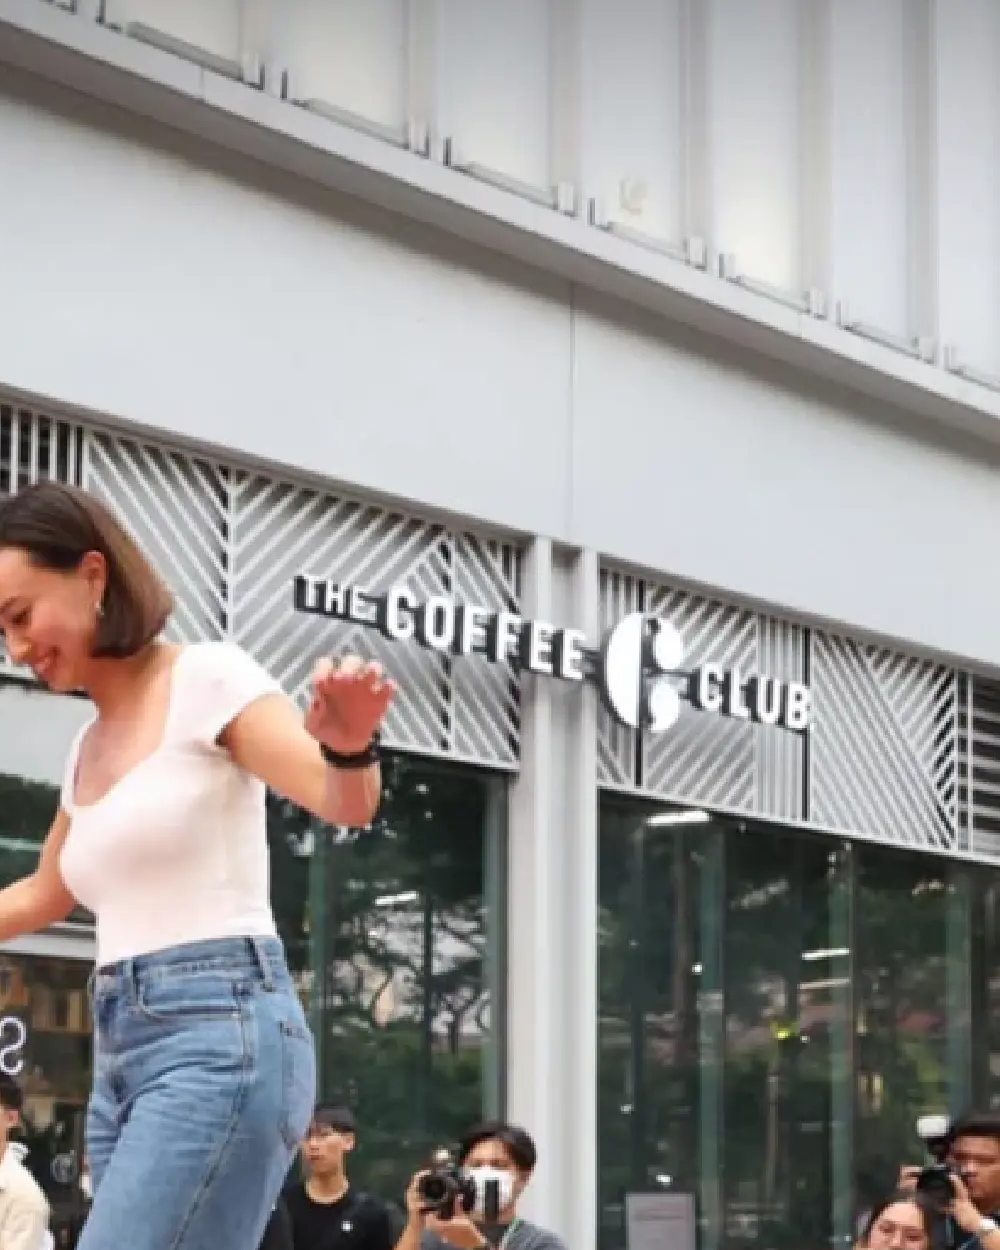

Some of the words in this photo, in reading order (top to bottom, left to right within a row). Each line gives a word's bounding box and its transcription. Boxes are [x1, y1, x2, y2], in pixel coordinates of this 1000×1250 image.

[294, 575, 377, 623] THE
[384, 583, 586, 681] COFFEE
[698, 660, 810, 731] CLUB
